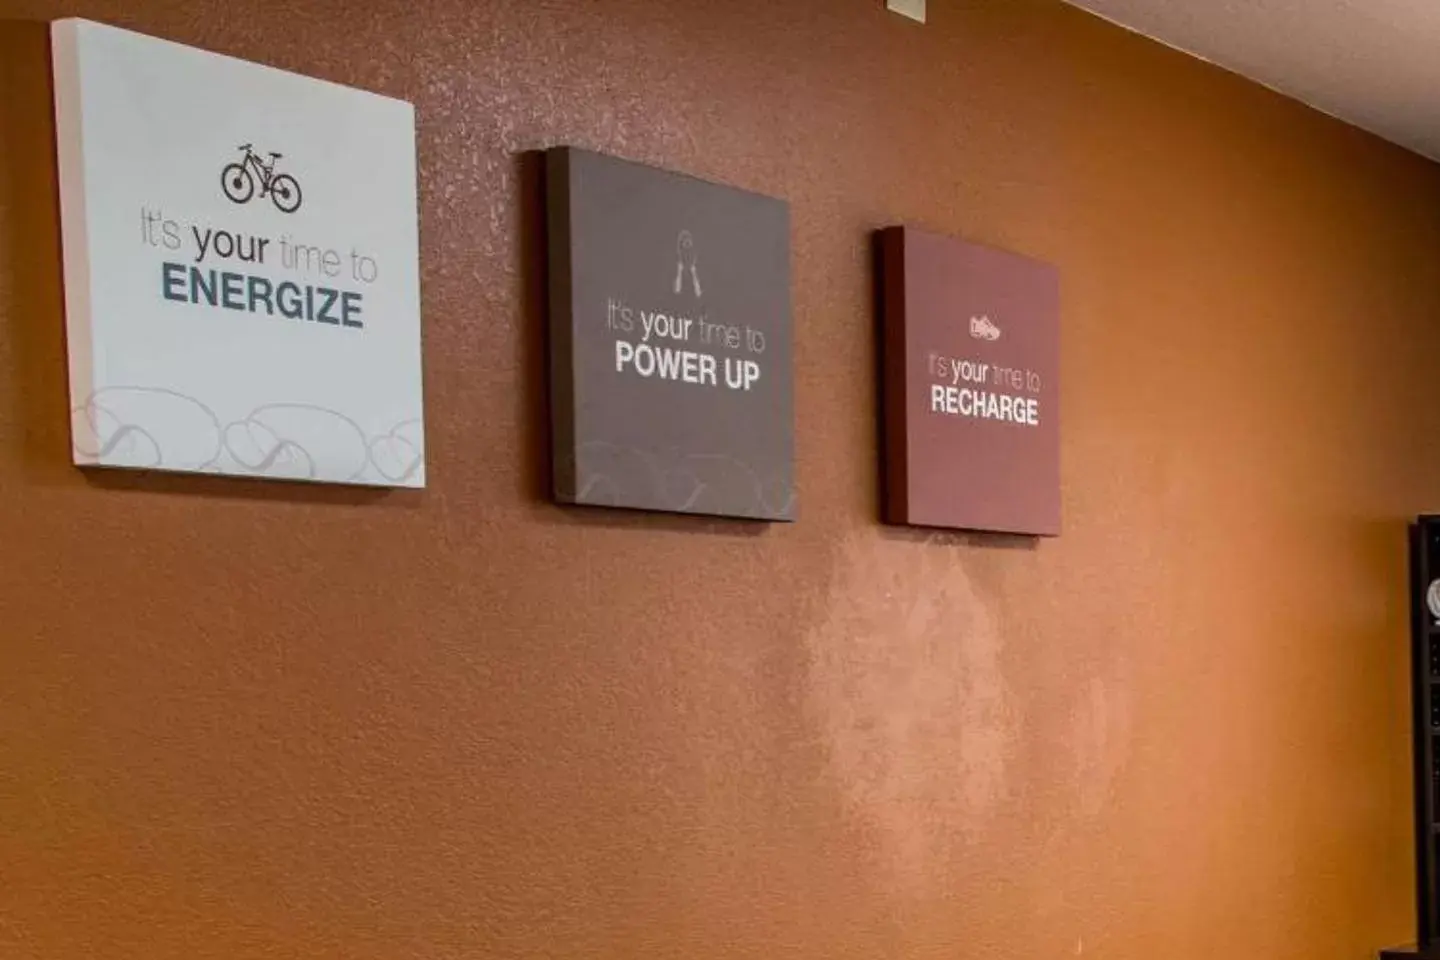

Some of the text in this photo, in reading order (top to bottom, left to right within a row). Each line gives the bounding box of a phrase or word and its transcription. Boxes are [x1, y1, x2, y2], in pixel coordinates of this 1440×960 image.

[140, 206, 378, 284] It's your time to
[162, 261, 364, 329] ENERGIZE
[607, 296, 767, 354] It's your time to
[615, 339, 761, 391] POWER UP
[951, 358, 989, 386] your
[1026, 368, 1041, 394] to
[931, 384, 1040, 426] RECHARGE
